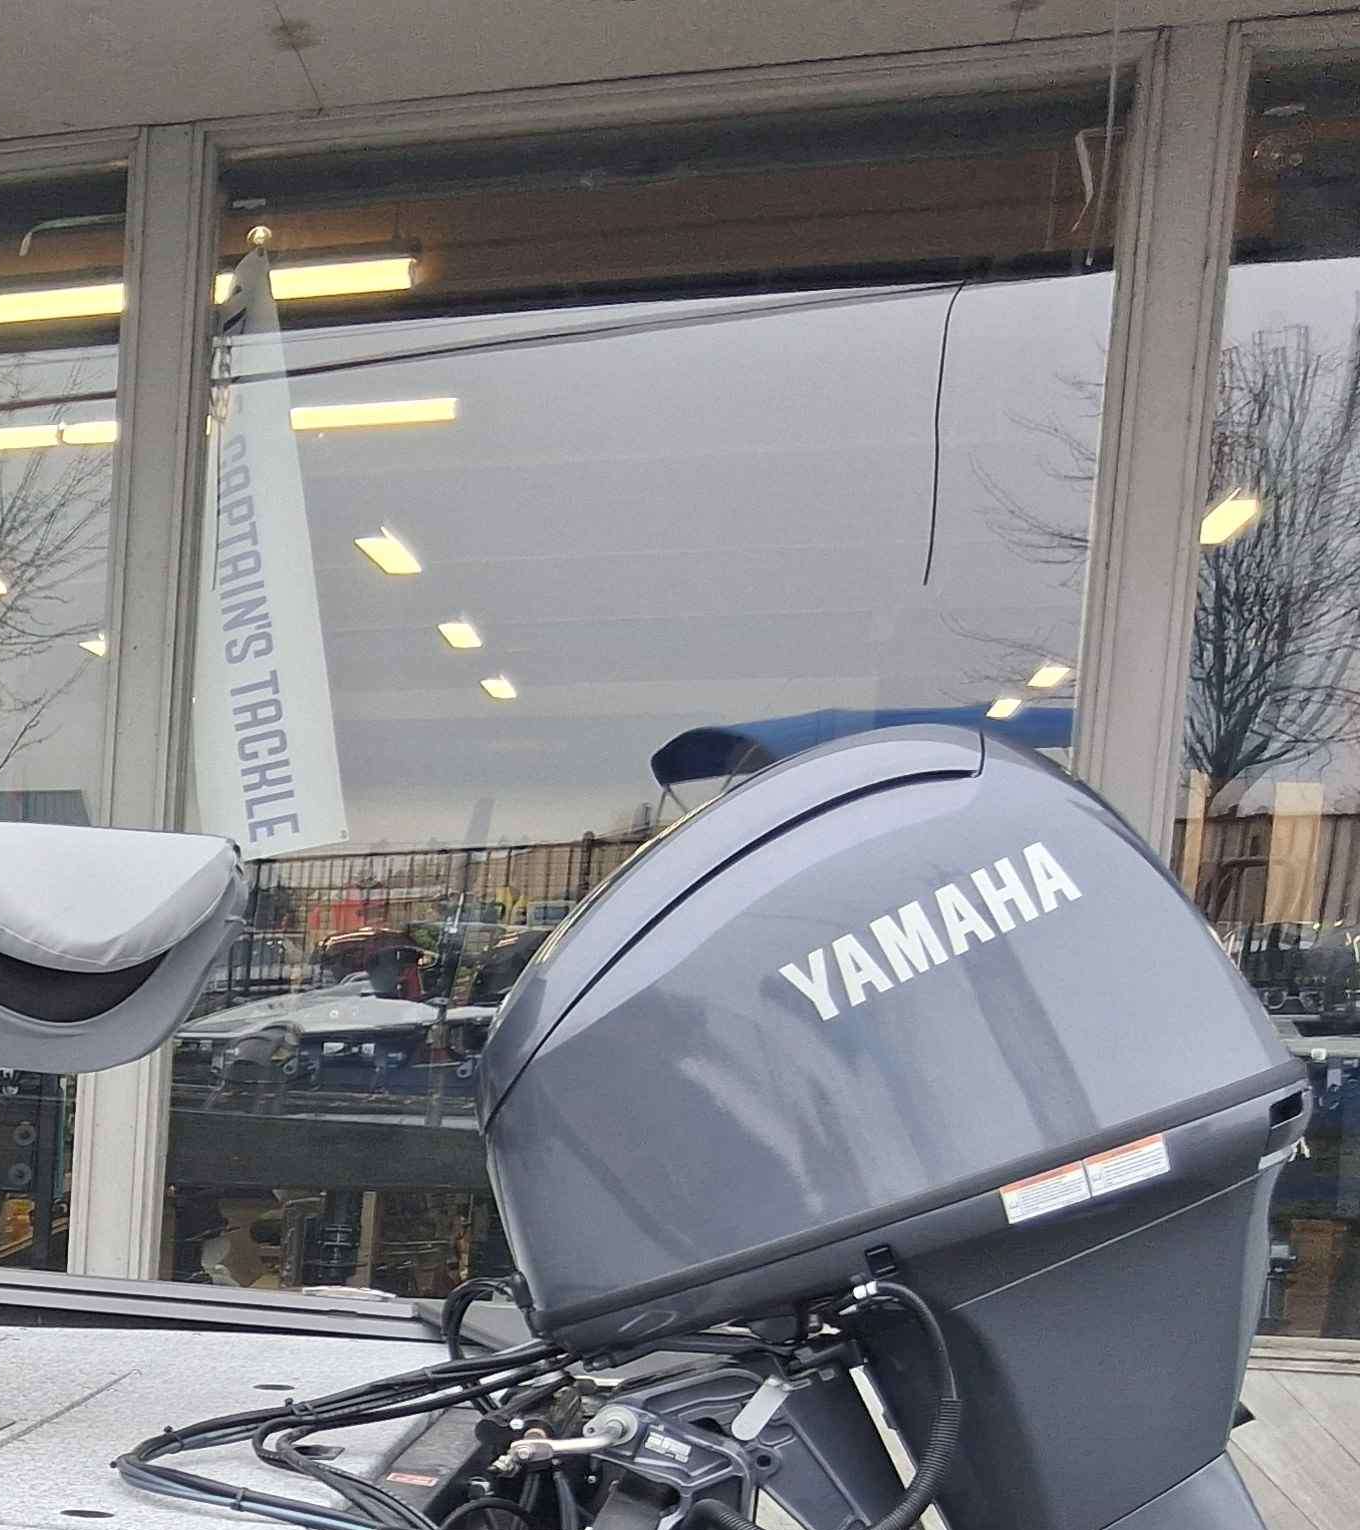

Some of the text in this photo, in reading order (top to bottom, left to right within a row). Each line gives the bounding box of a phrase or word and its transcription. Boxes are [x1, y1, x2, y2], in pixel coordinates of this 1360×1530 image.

[216, 432, 301, 844] CAPTAIN'S TACKLE
[777, 841, 1083, 1022] YAMAHA
